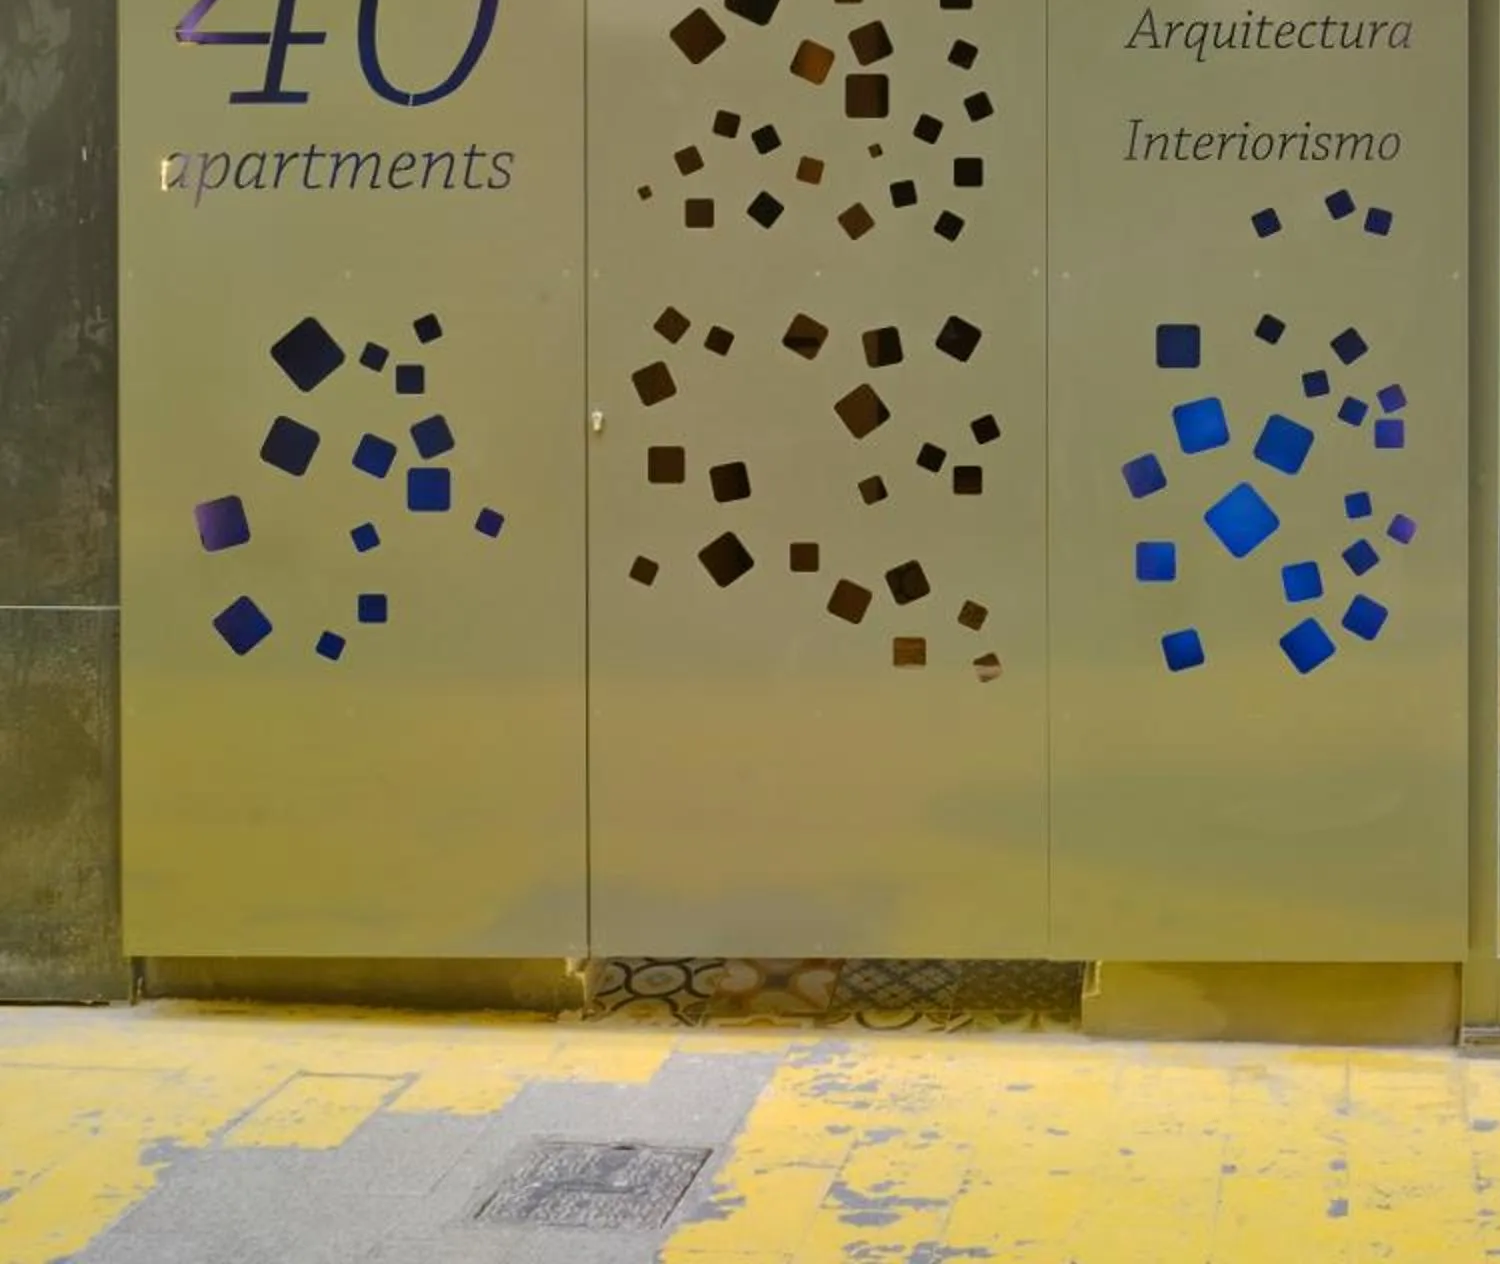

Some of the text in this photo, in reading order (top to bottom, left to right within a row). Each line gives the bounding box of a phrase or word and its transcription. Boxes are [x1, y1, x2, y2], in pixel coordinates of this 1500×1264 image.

[1123, 6, 1413, 63] Arquitectura
[1123, 118, 1402, 161] Interiorismo
[160, 140, 517, 208] apartments
